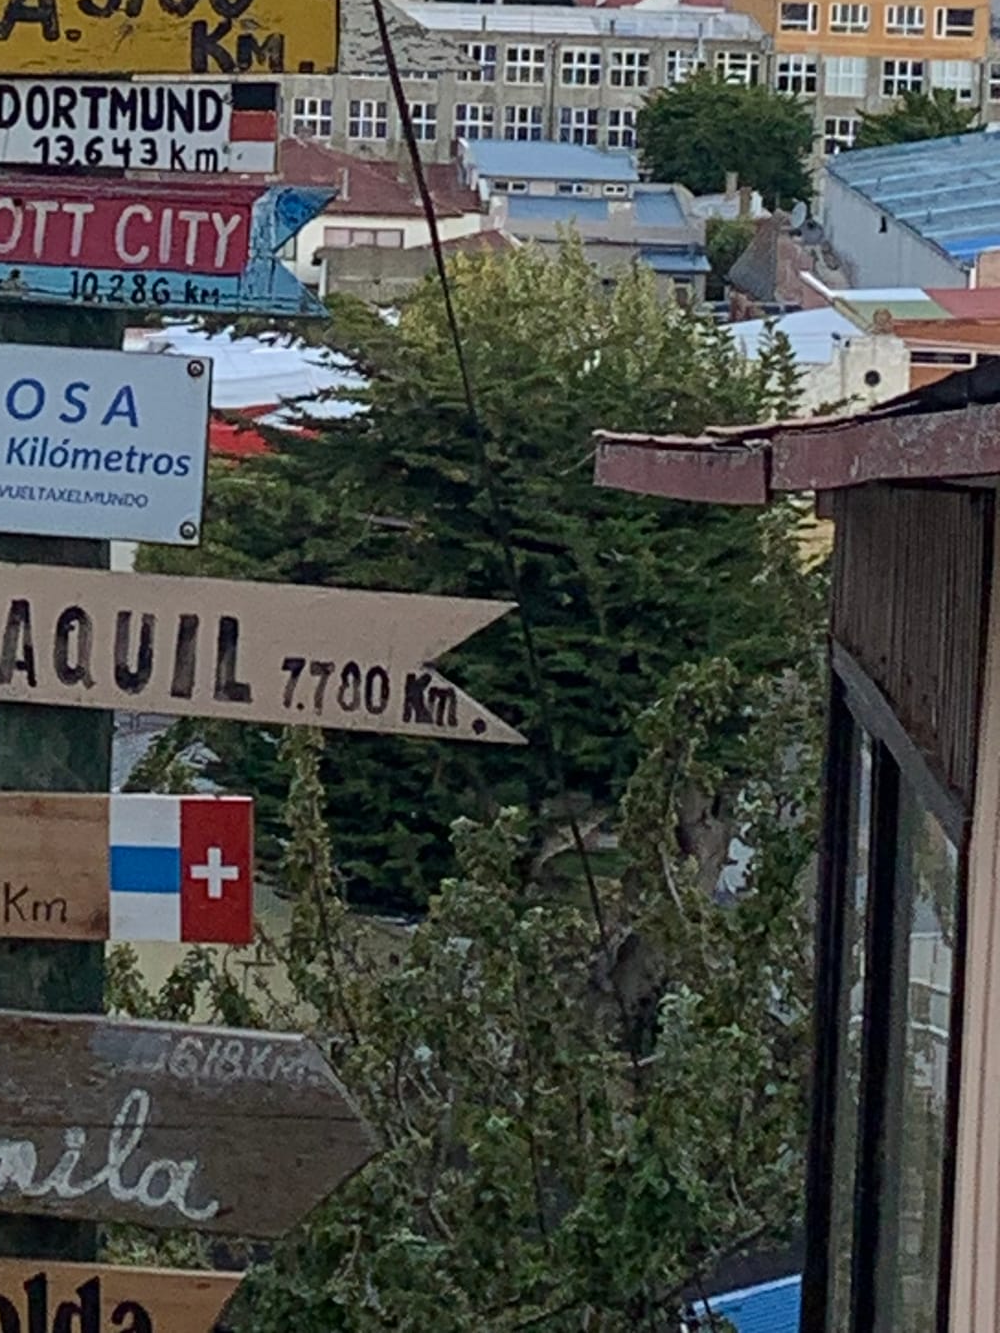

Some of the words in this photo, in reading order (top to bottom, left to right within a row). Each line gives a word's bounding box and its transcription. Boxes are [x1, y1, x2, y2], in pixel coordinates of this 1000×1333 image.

[115, 204, 242, 268] CITY
[6, 433, 192, 478] Kilómetros
[4, 881, 68, 926] Km
